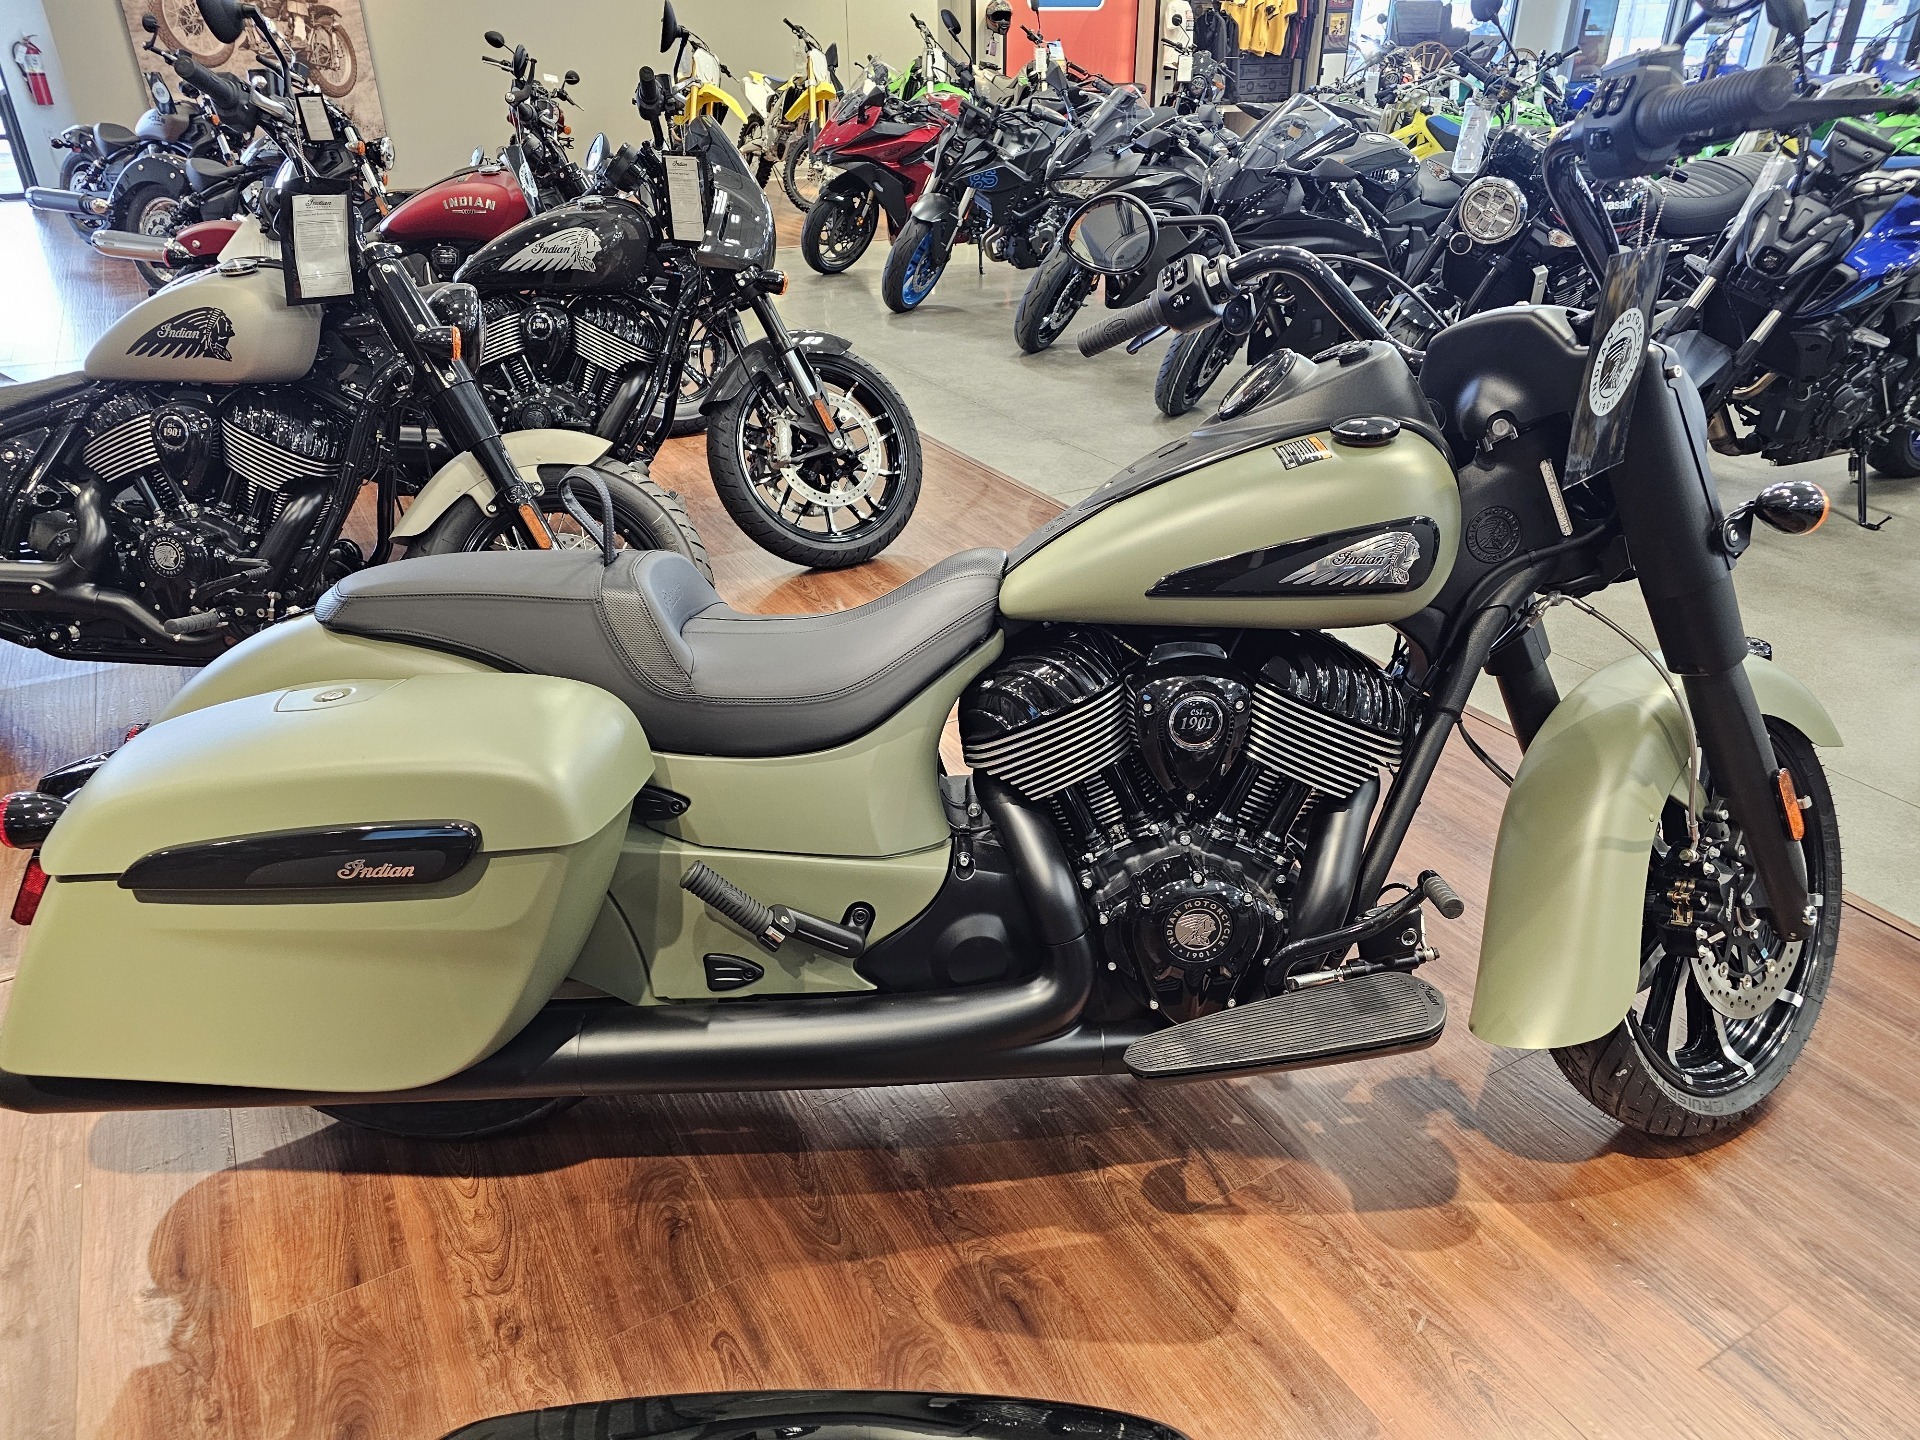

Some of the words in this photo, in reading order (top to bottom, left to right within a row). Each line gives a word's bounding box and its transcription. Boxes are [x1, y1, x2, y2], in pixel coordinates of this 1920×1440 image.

[443, 195, 496, 211] INDIAN
[531, 241, 571, 255] Indian
[157, 322, 200, 339] Indian
[1592, 332, 1613, 399] INDIAN
[1618, 312, 1642, 384] MOTORCYCLE
[163, 427, 181, 437] 1901
[1331, 551, 1385, 566] Indian
[1180, 716, 1215, 731] 1901
[337, 859, 415, 879] Indian
[1822, 821, 1839, 930] METZELER
[1166, 909, 1181, 948] INDIAN
[1184, 900, 1231, 947] MOTORCYCLE
[1418, 983, 1440, 1006] Indian
